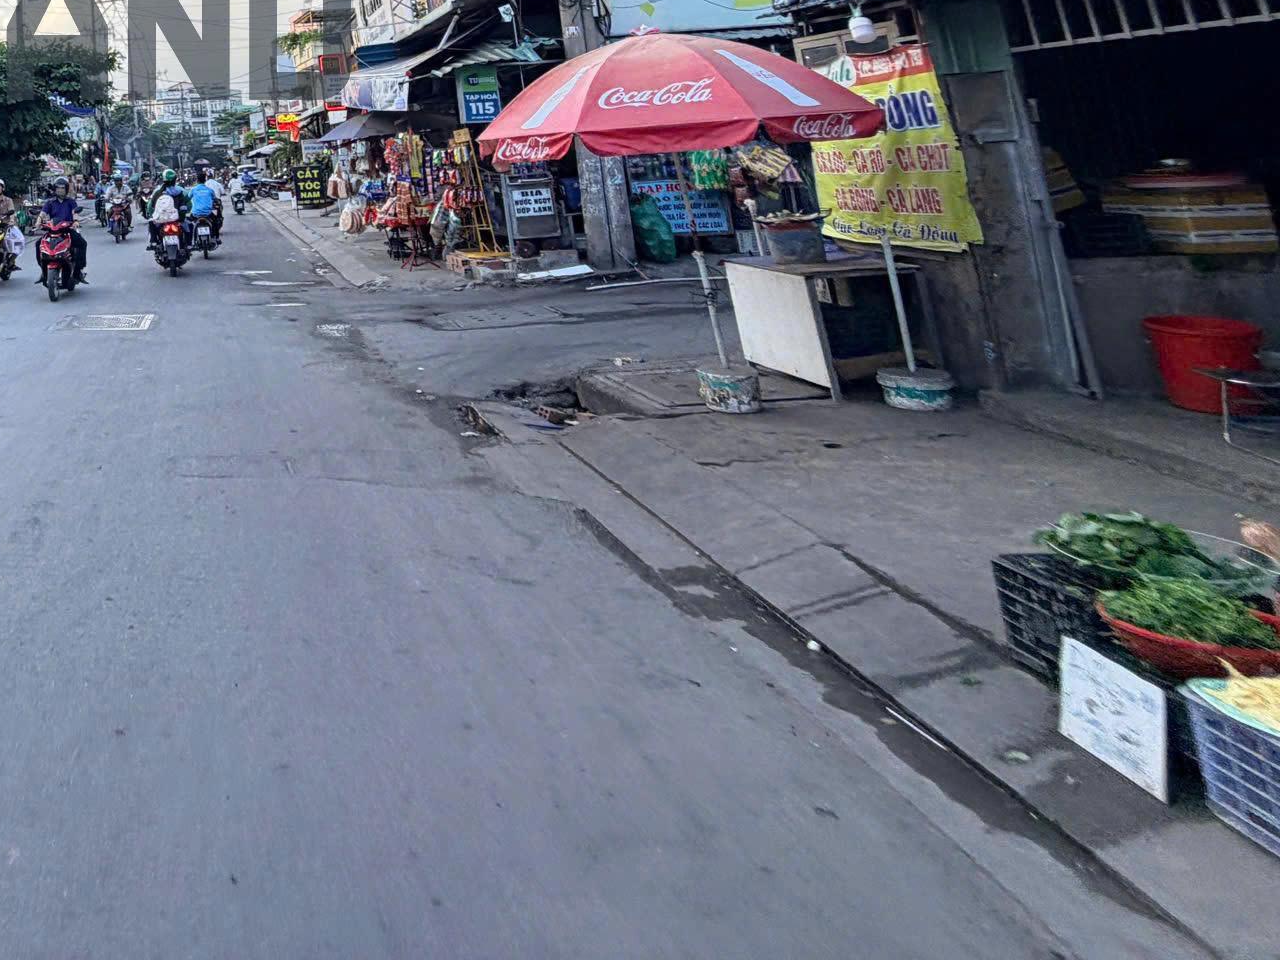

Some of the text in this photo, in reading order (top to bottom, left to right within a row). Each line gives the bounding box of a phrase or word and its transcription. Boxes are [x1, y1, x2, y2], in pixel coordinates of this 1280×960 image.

[465, 94, 479, 102] TẠP
[598, 77, 715, 110] Coca-Cola
[469, 101, 495, 115] 115
[296, 167, 319, 179] CẮT
[297, 180, 320, 190] TÓC
[300, 191, 320, 199] NAM
